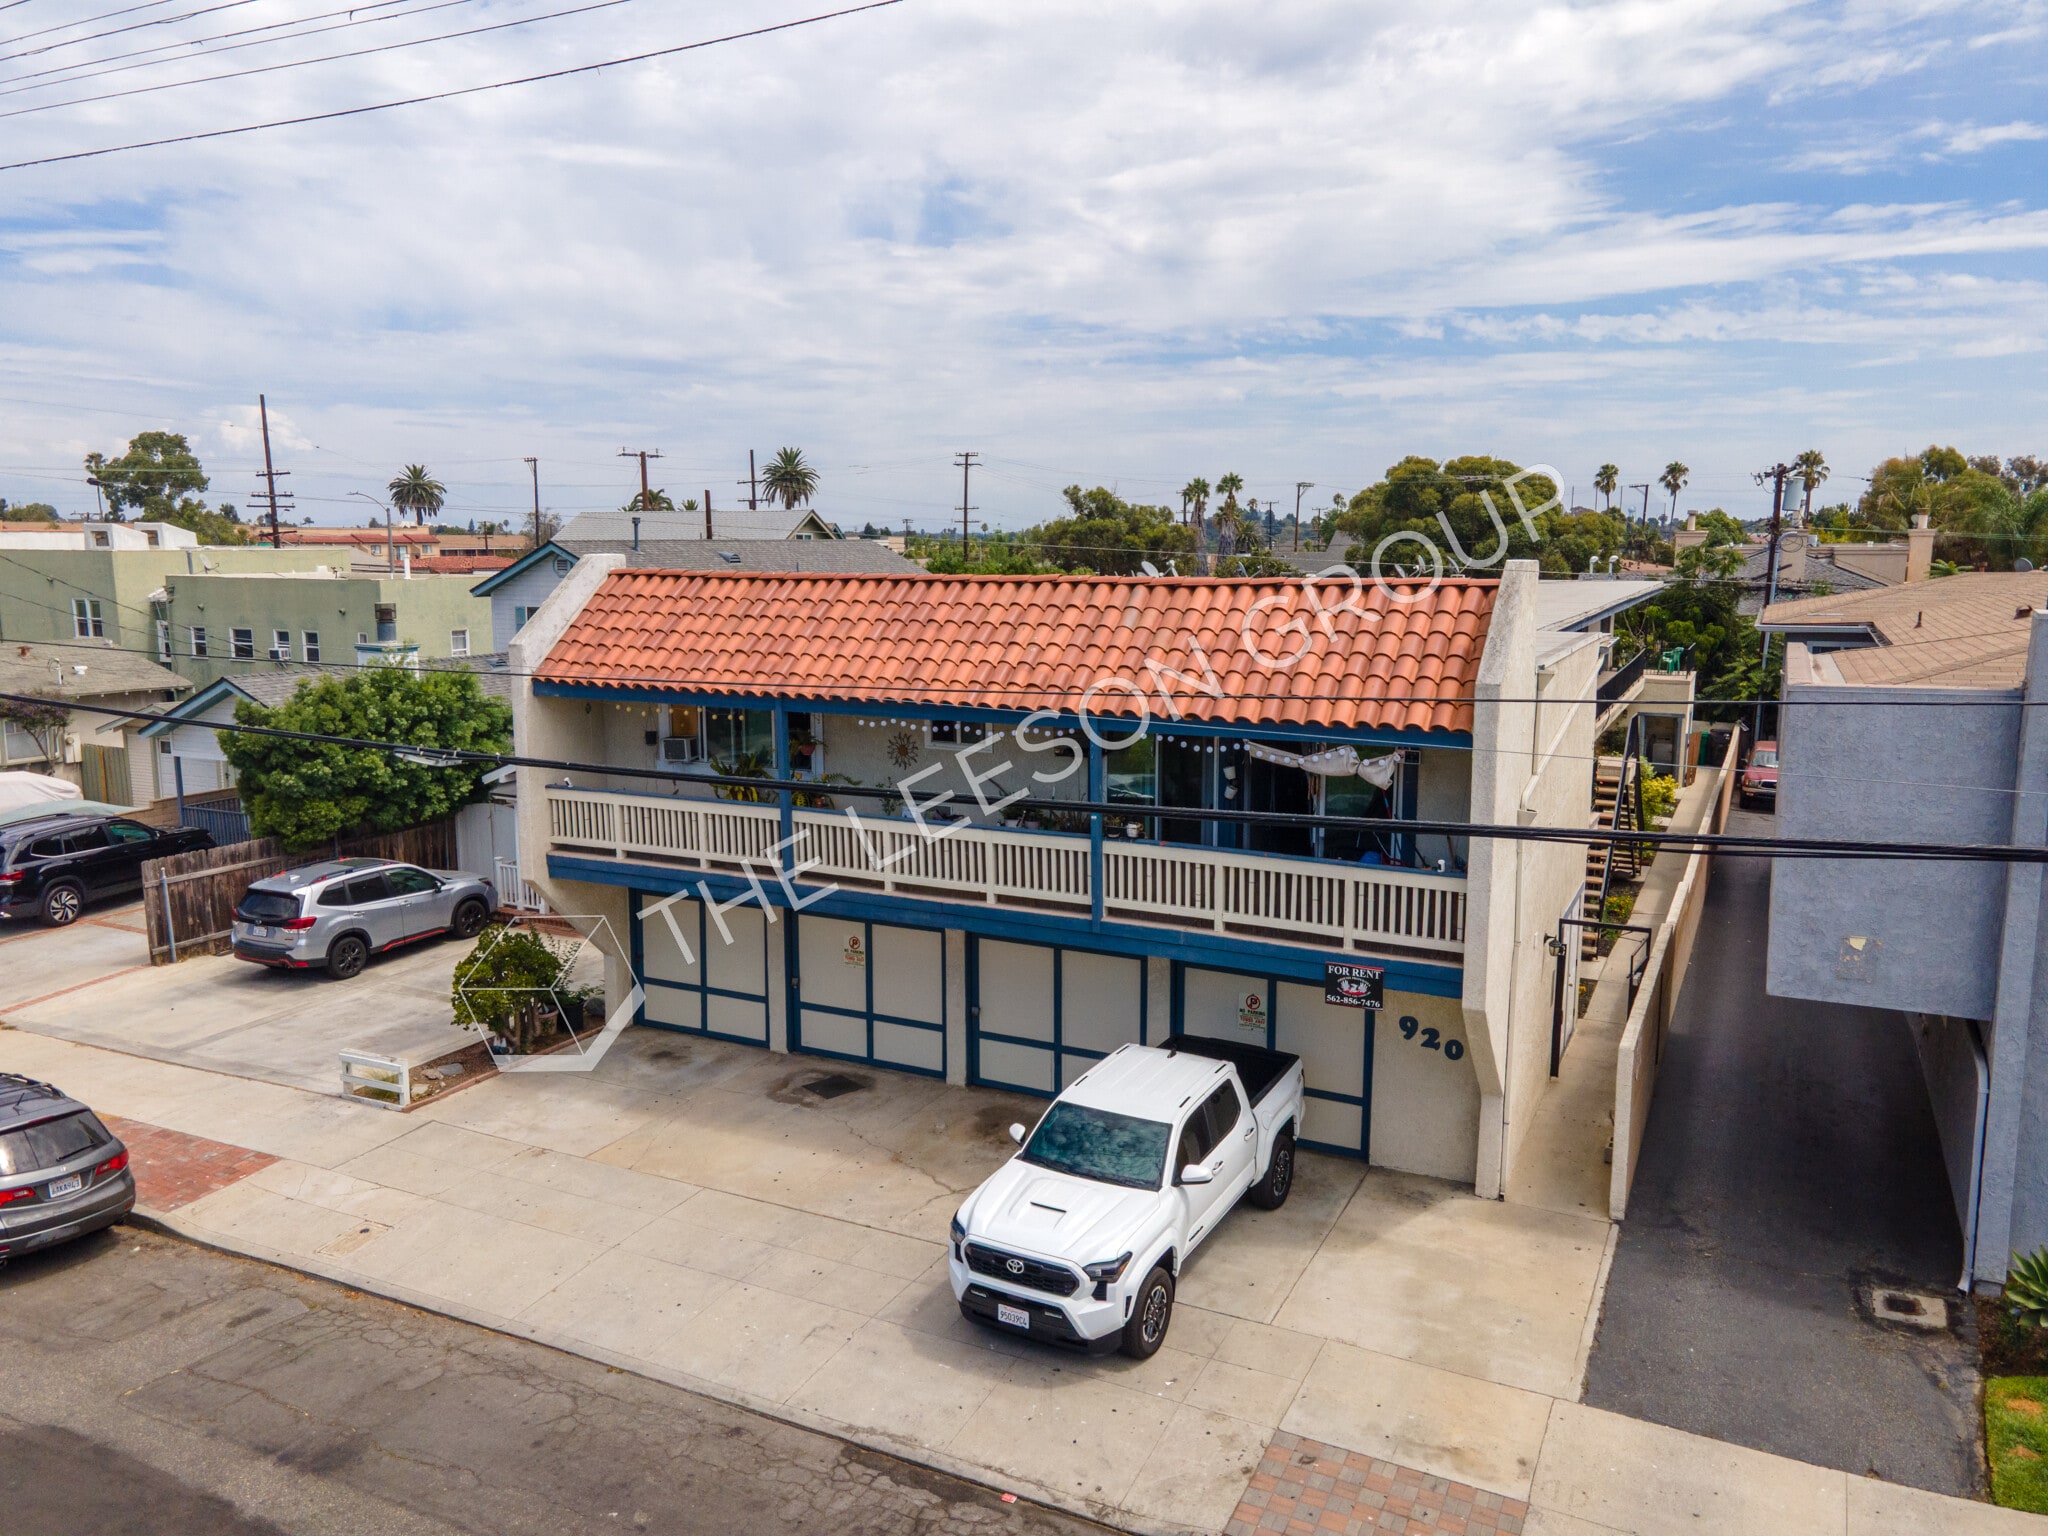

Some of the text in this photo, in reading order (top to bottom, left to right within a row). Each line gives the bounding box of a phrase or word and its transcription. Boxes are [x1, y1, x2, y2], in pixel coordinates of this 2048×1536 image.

[1328, 965, 1381, 979] FOR RENT
[1326, 994, 1380, 1007] 562-856-7476
[1399, 1016, 1464, 1060] 920
